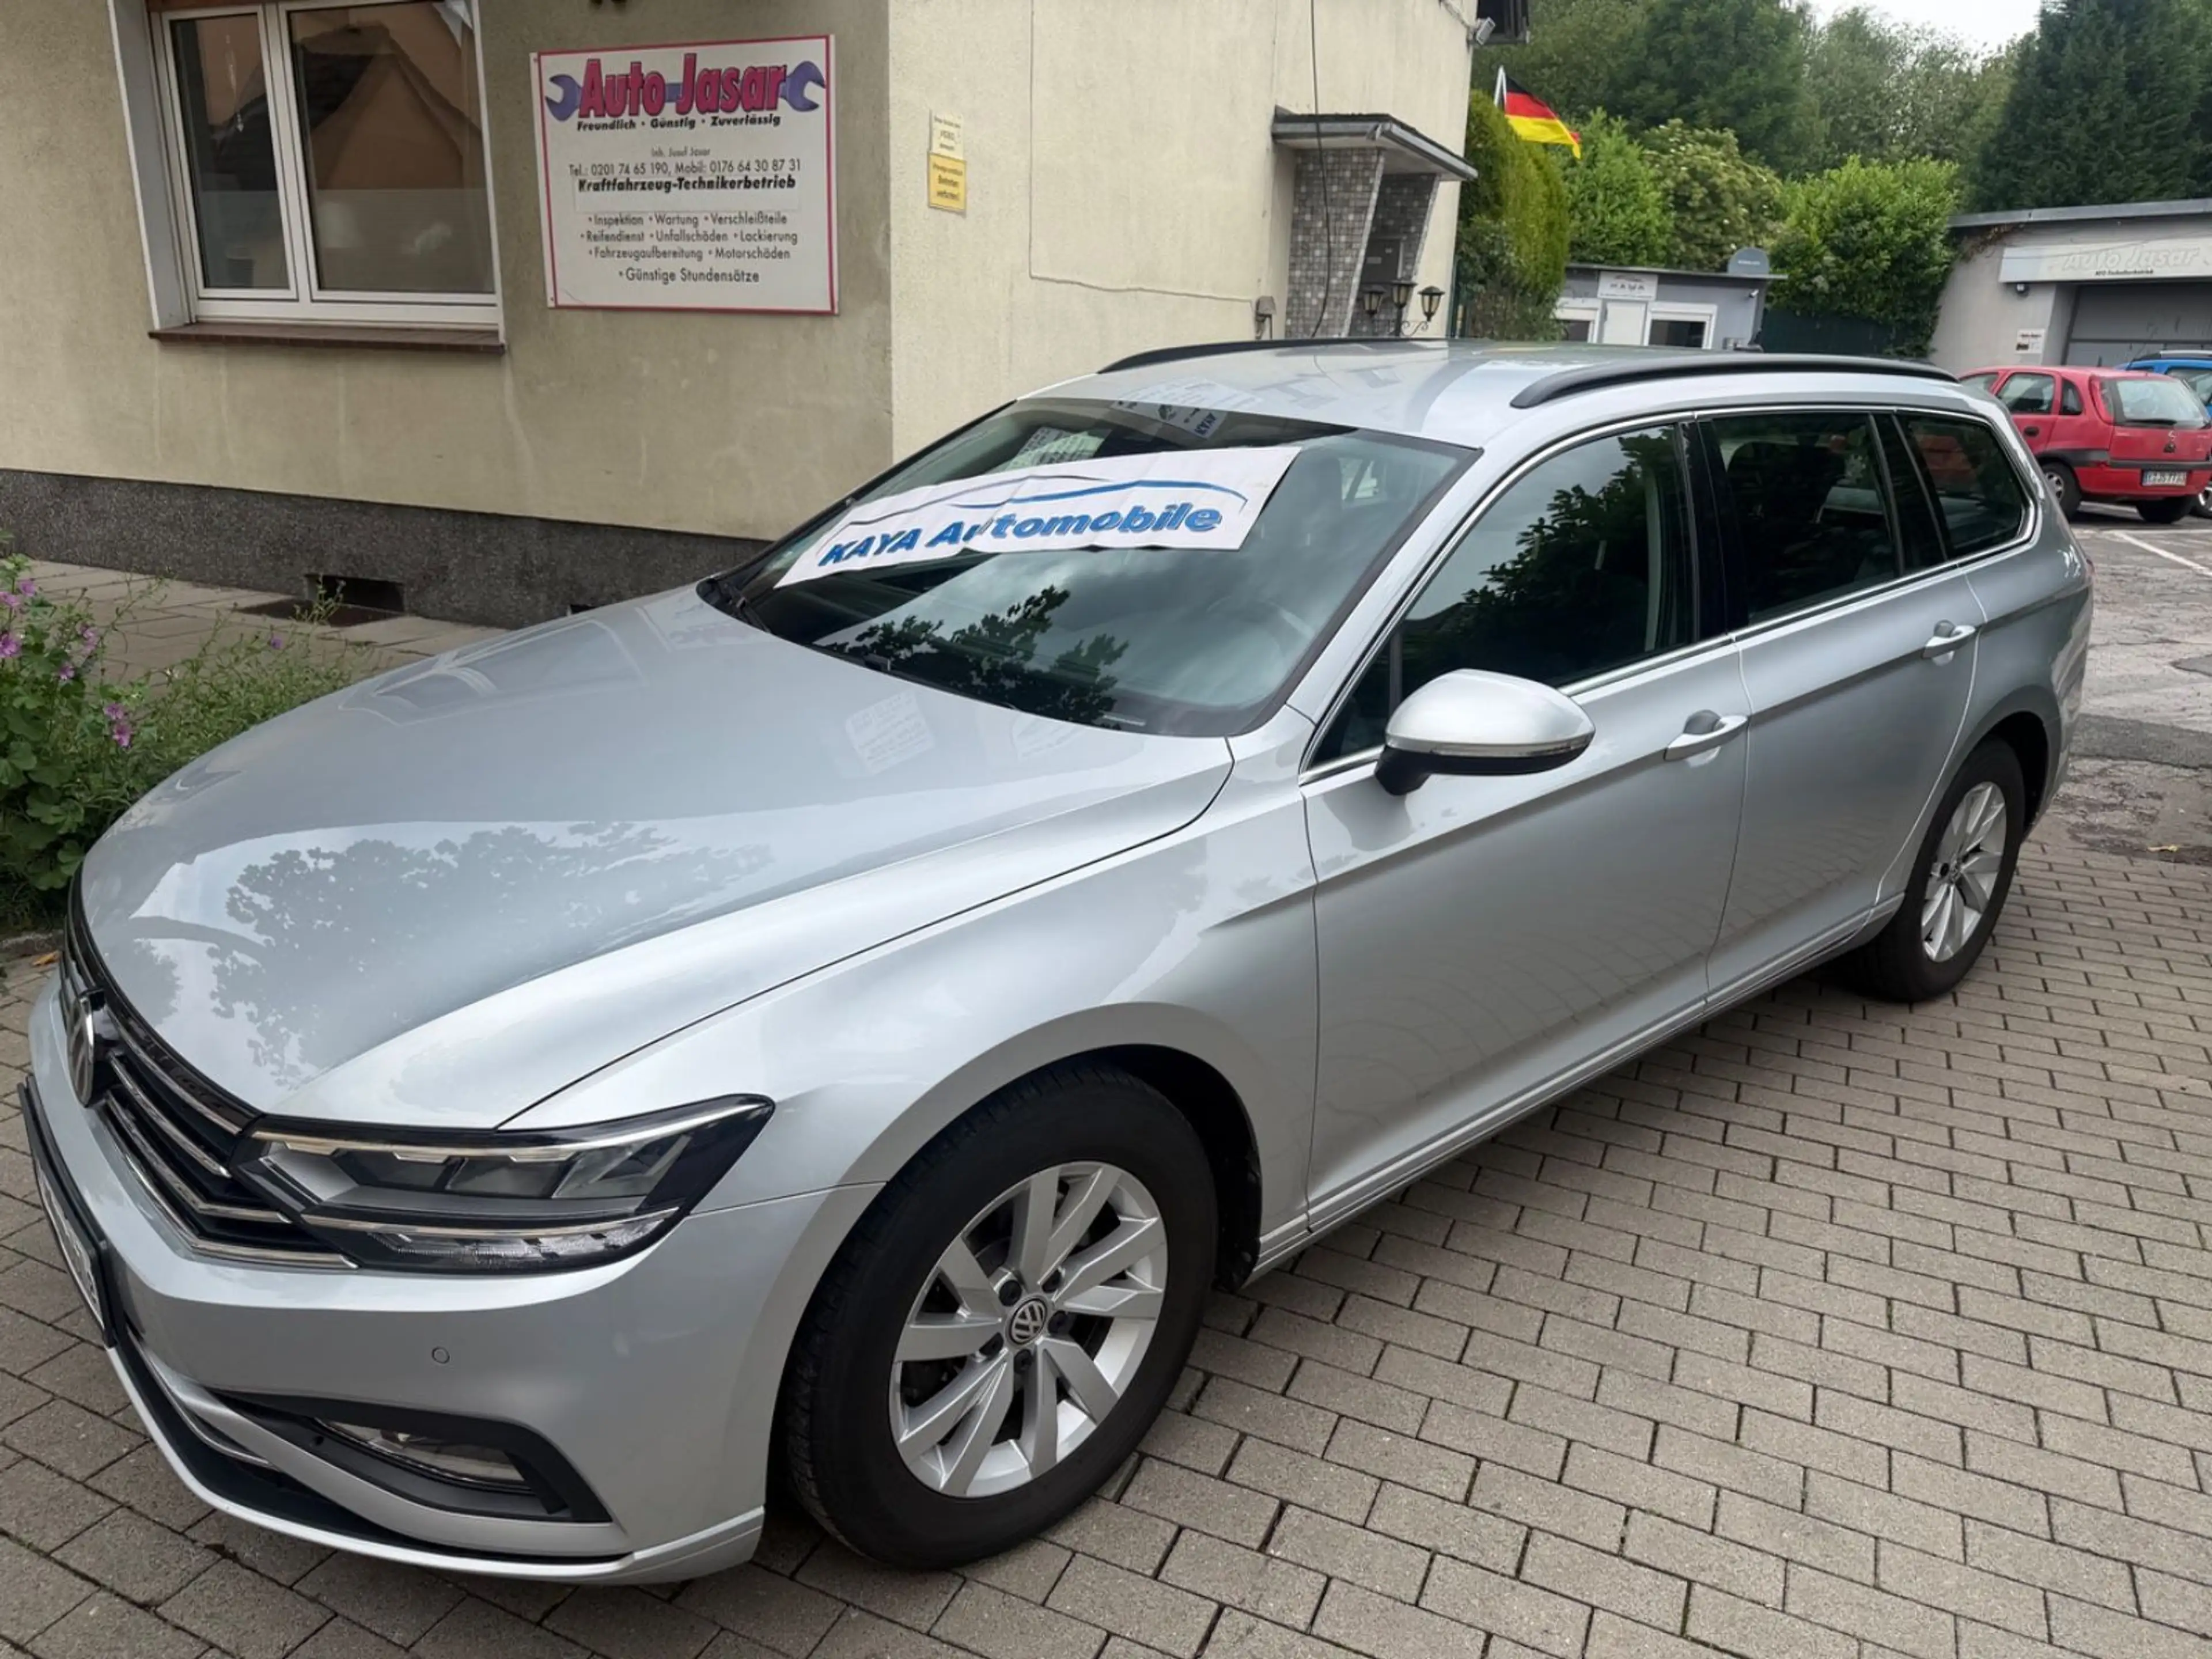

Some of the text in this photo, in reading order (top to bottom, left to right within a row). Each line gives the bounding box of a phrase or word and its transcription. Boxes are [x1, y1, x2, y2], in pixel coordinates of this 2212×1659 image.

[578, 53, 787, 118] Auto Jasar
[577, 113, 781, 131] Freundlich Günstig Zuverlässig
[591, 163, 615, 176] 0201
[618, 162, 630, 175] 74
[634, 162, 646, 175] 65
[709, 160, 734, 173] 0176
[737, 159, 751, 172] 64
[755, 158, 768, 172] 30
[771, 158, 785, 172] 87
[789, 158, 801, 172] 31
[578, 174, 796, 194] Kraftfahrzeug-Technikerbetrieb
[818, 528, 922, 567] KAYA
